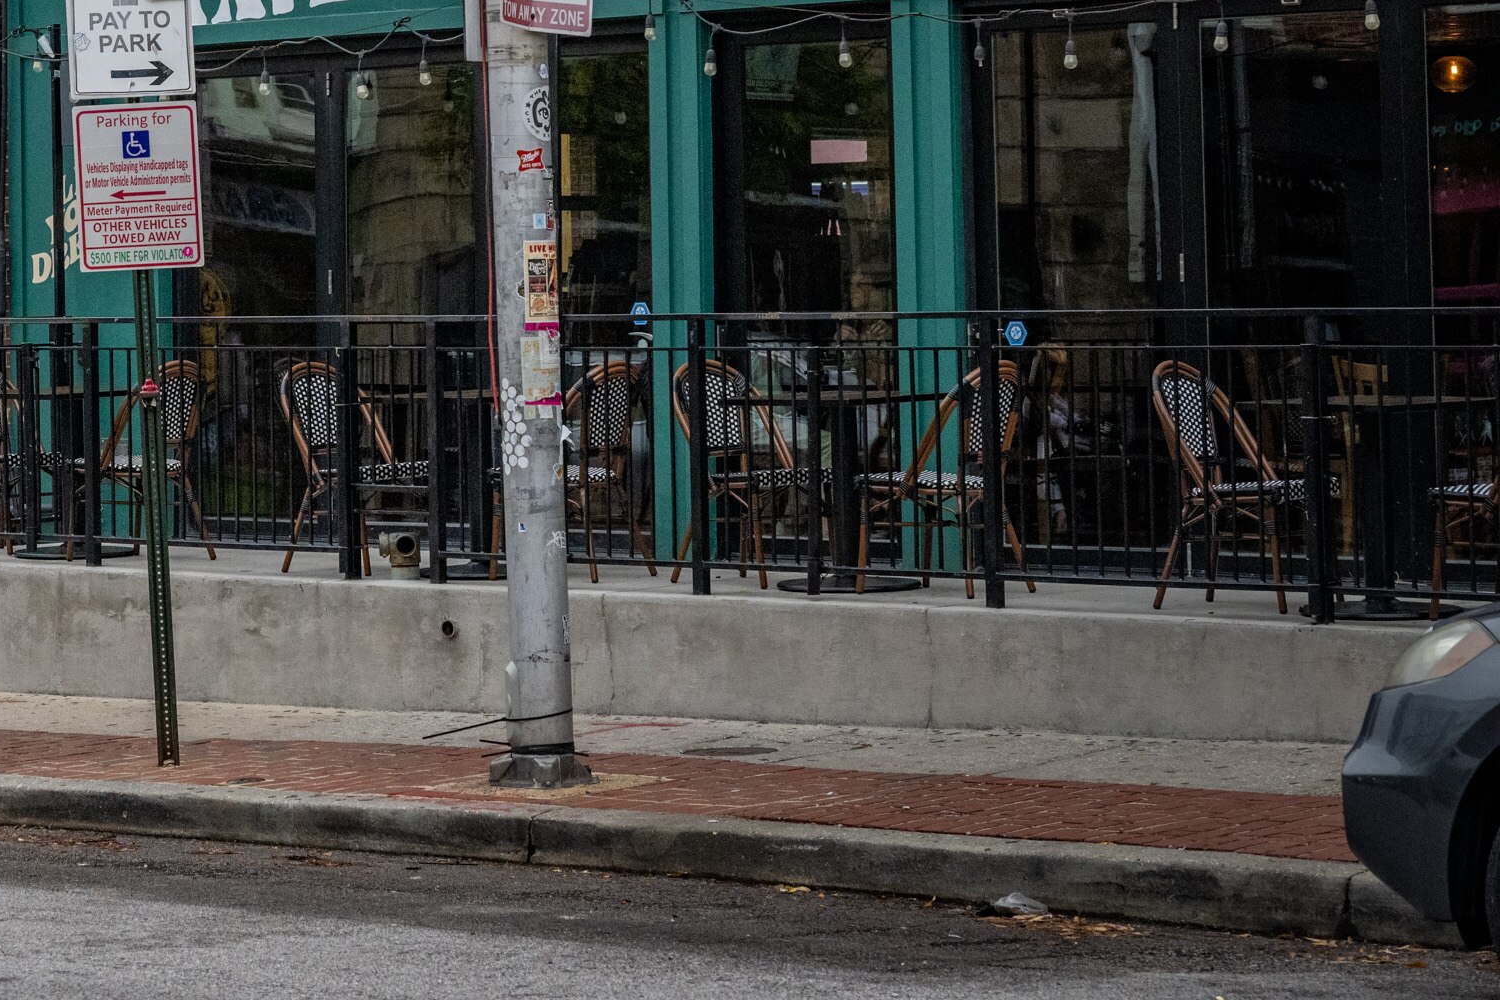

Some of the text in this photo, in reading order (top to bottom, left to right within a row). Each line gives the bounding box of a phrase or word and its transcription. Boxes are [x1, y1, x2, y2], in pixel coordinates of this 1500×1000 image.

[89, 10, 171, 31] PAY TO
[503, 0, 585, 27] TOW AWAY ZONE
[99, 33, 163, 53] PARK
[96, 112, 172, 128] Parking for
[86, 159, 189, 174] Vehicles Displaying Handicapped tags
[85, 173, 192, 188] or Motor Vehicle Administration permits
[87, 201, 192, 217] Meter Payment Required
[93, 218, 188, 233] OTHER VEHICLES
[102, 230, 181, 244] TOWED AWAY
[529, 244, 546, 253] LIVE
[90, 251, 112, 266] $500
[114, 250, 131, 263] FINE
